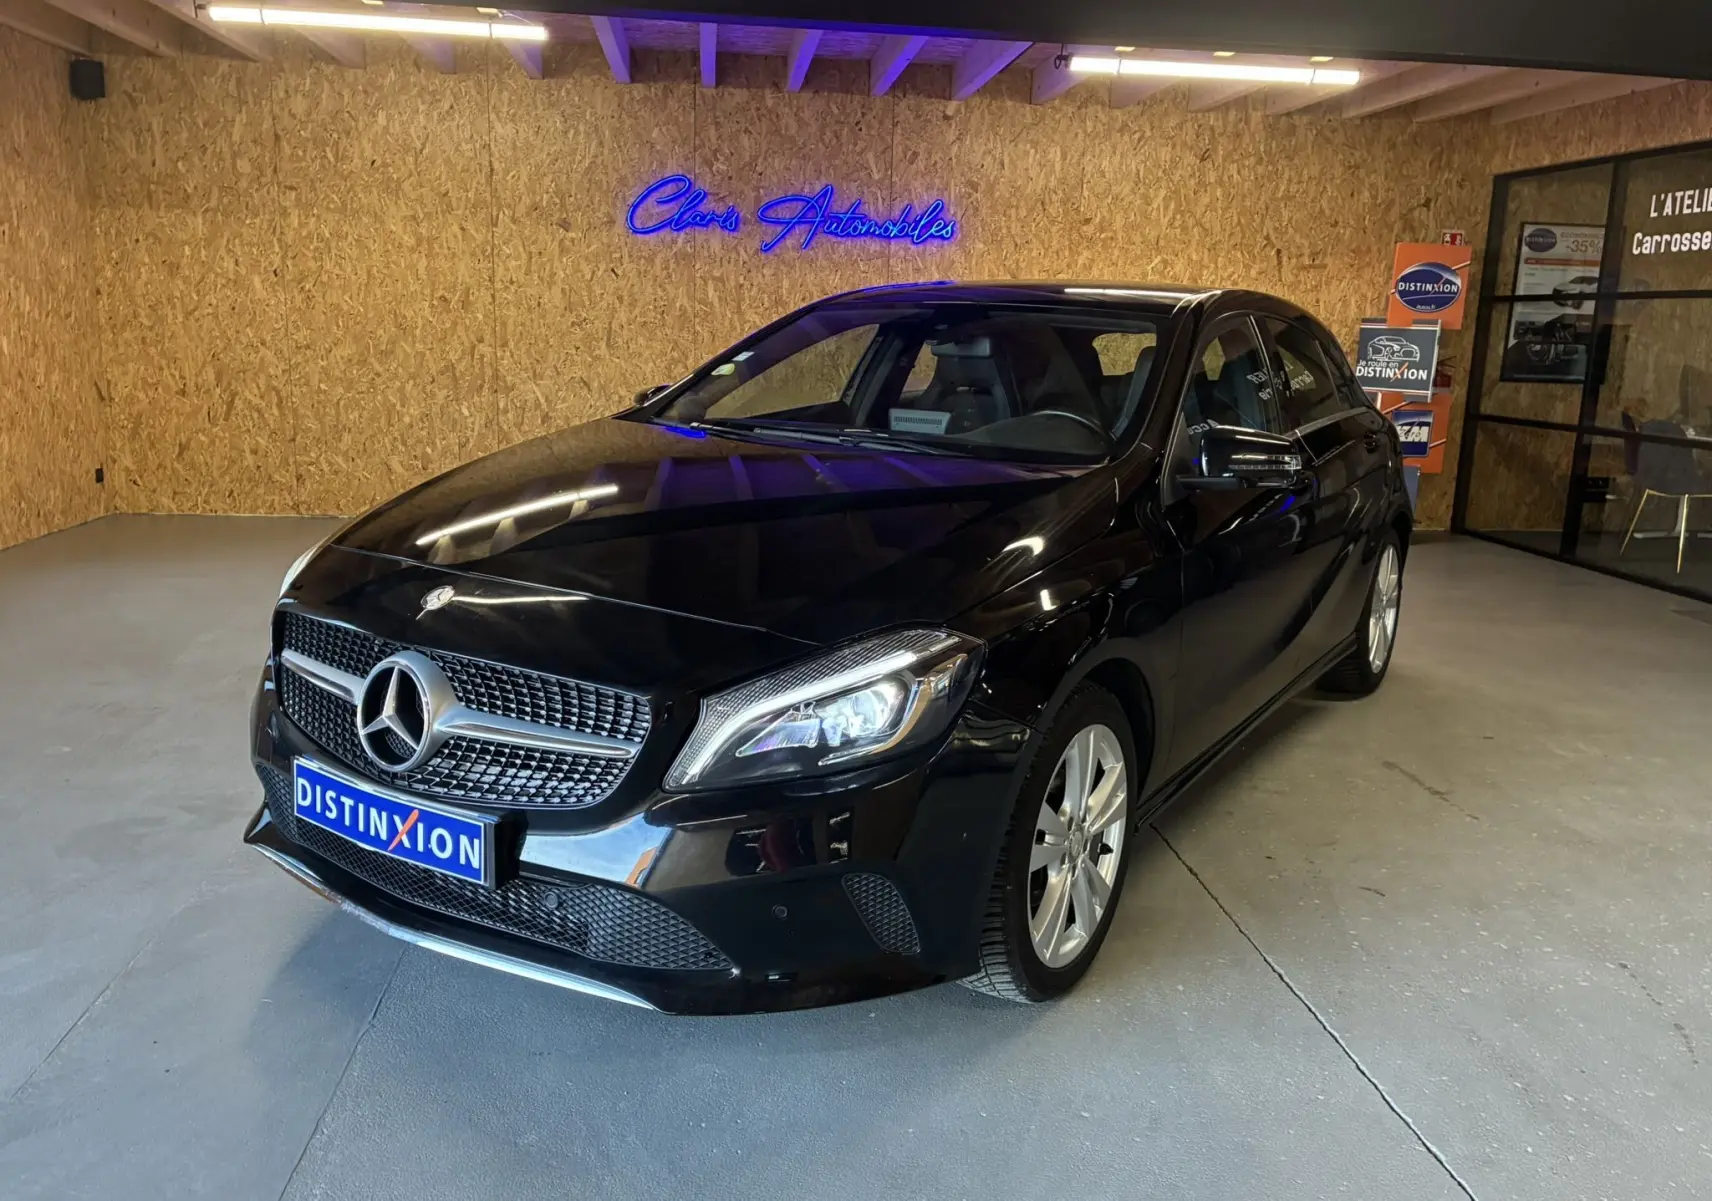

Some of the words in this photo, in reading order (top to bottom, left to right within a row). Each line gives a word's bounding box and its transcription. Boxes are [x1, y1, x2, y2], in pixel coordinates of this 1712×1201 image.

[626, 174, 740, 233] Claris
[757, 184, 956, 251] Automobiles
[1565, 239, 1602, 254] -35%
[1631, 231, 1712, 255] Carrosse
[1398, 279, 1458, 294] DISTINXION
[1356, 364, 1428, 381] DISTINXION
[297, 777, 480, 869] DISTINXION
